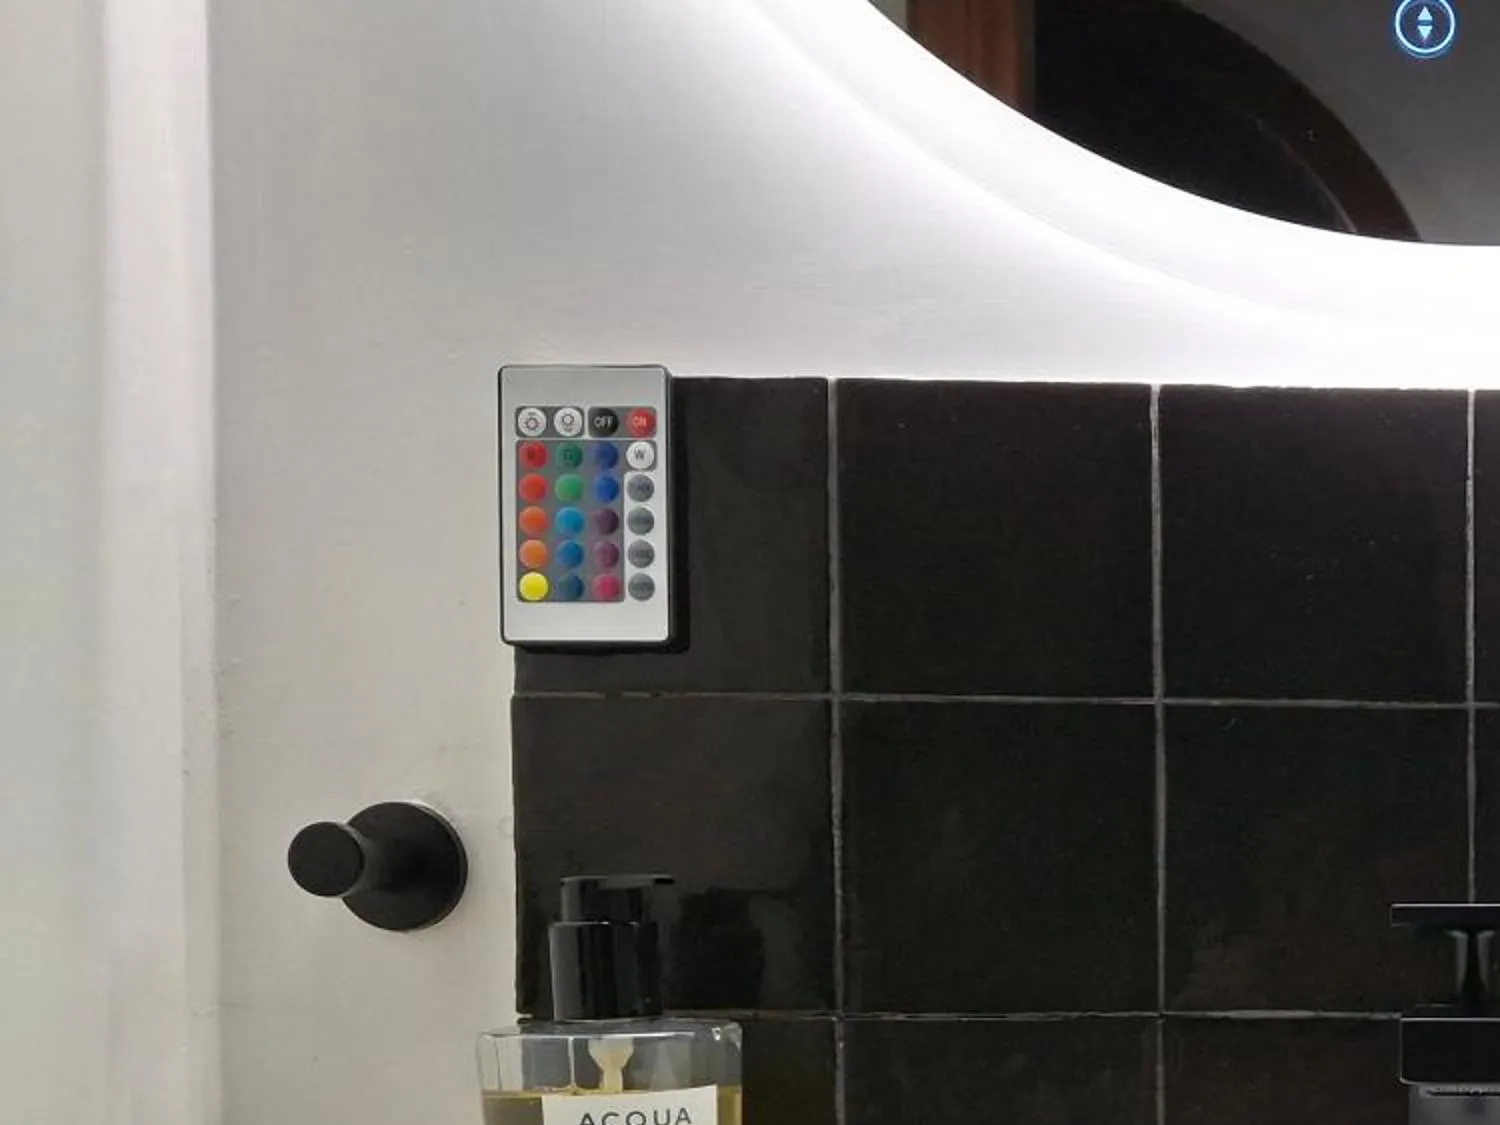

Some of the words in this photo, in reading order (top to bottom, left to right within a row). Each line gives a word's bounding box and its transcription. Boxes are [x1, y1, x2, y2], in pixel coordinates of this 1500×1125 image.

[593, 415, 615, 429] OFF
[632, 416, 648, 428] ON
[634, 447, 647, 461] W
